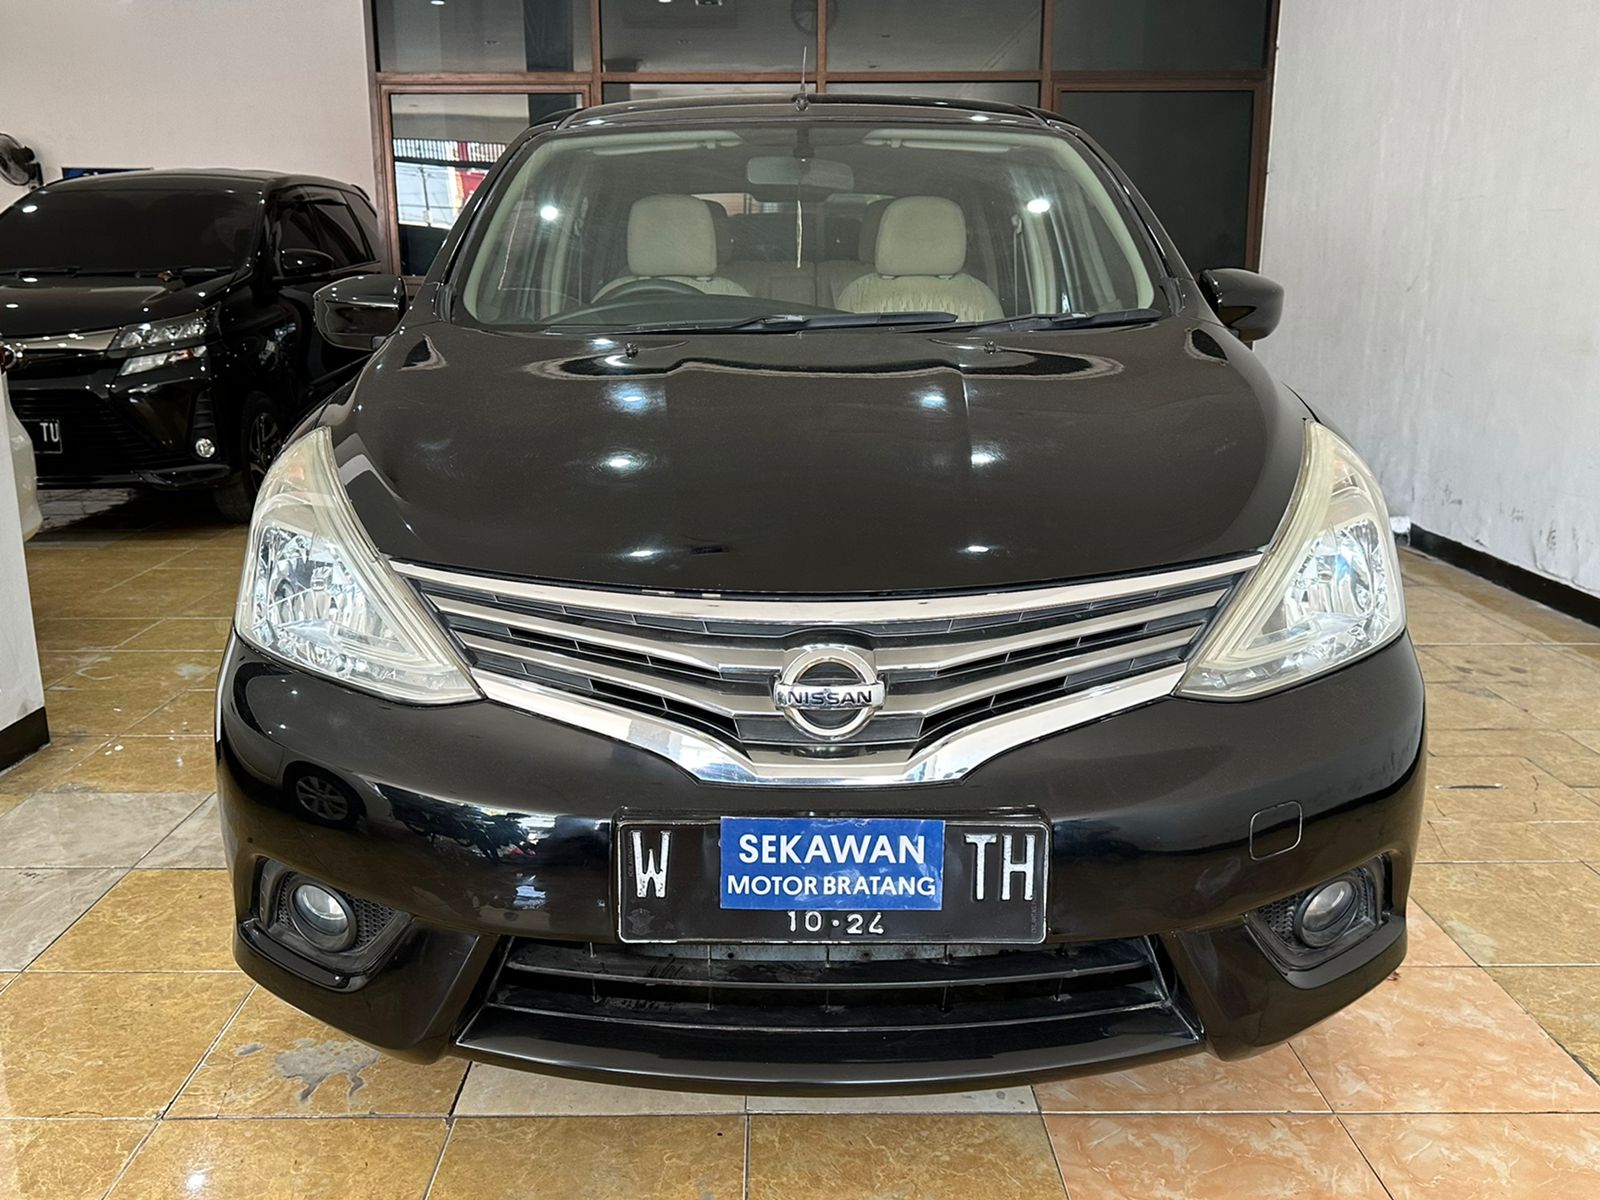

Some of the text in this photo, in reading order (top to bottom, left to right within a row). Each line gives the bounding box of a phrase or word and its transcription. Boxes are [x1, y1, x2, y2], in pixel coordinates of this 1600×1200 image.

[40, 422, 60, 442] TU
[788, 690, 872, 705] NISSAN
[738, 834, 925, 864] SEKAWAN
[631, 830, 671, 898] W
[965, 834, 1035, 900] TH
[727, 875, 936, 896] MOTOR BRATANG
